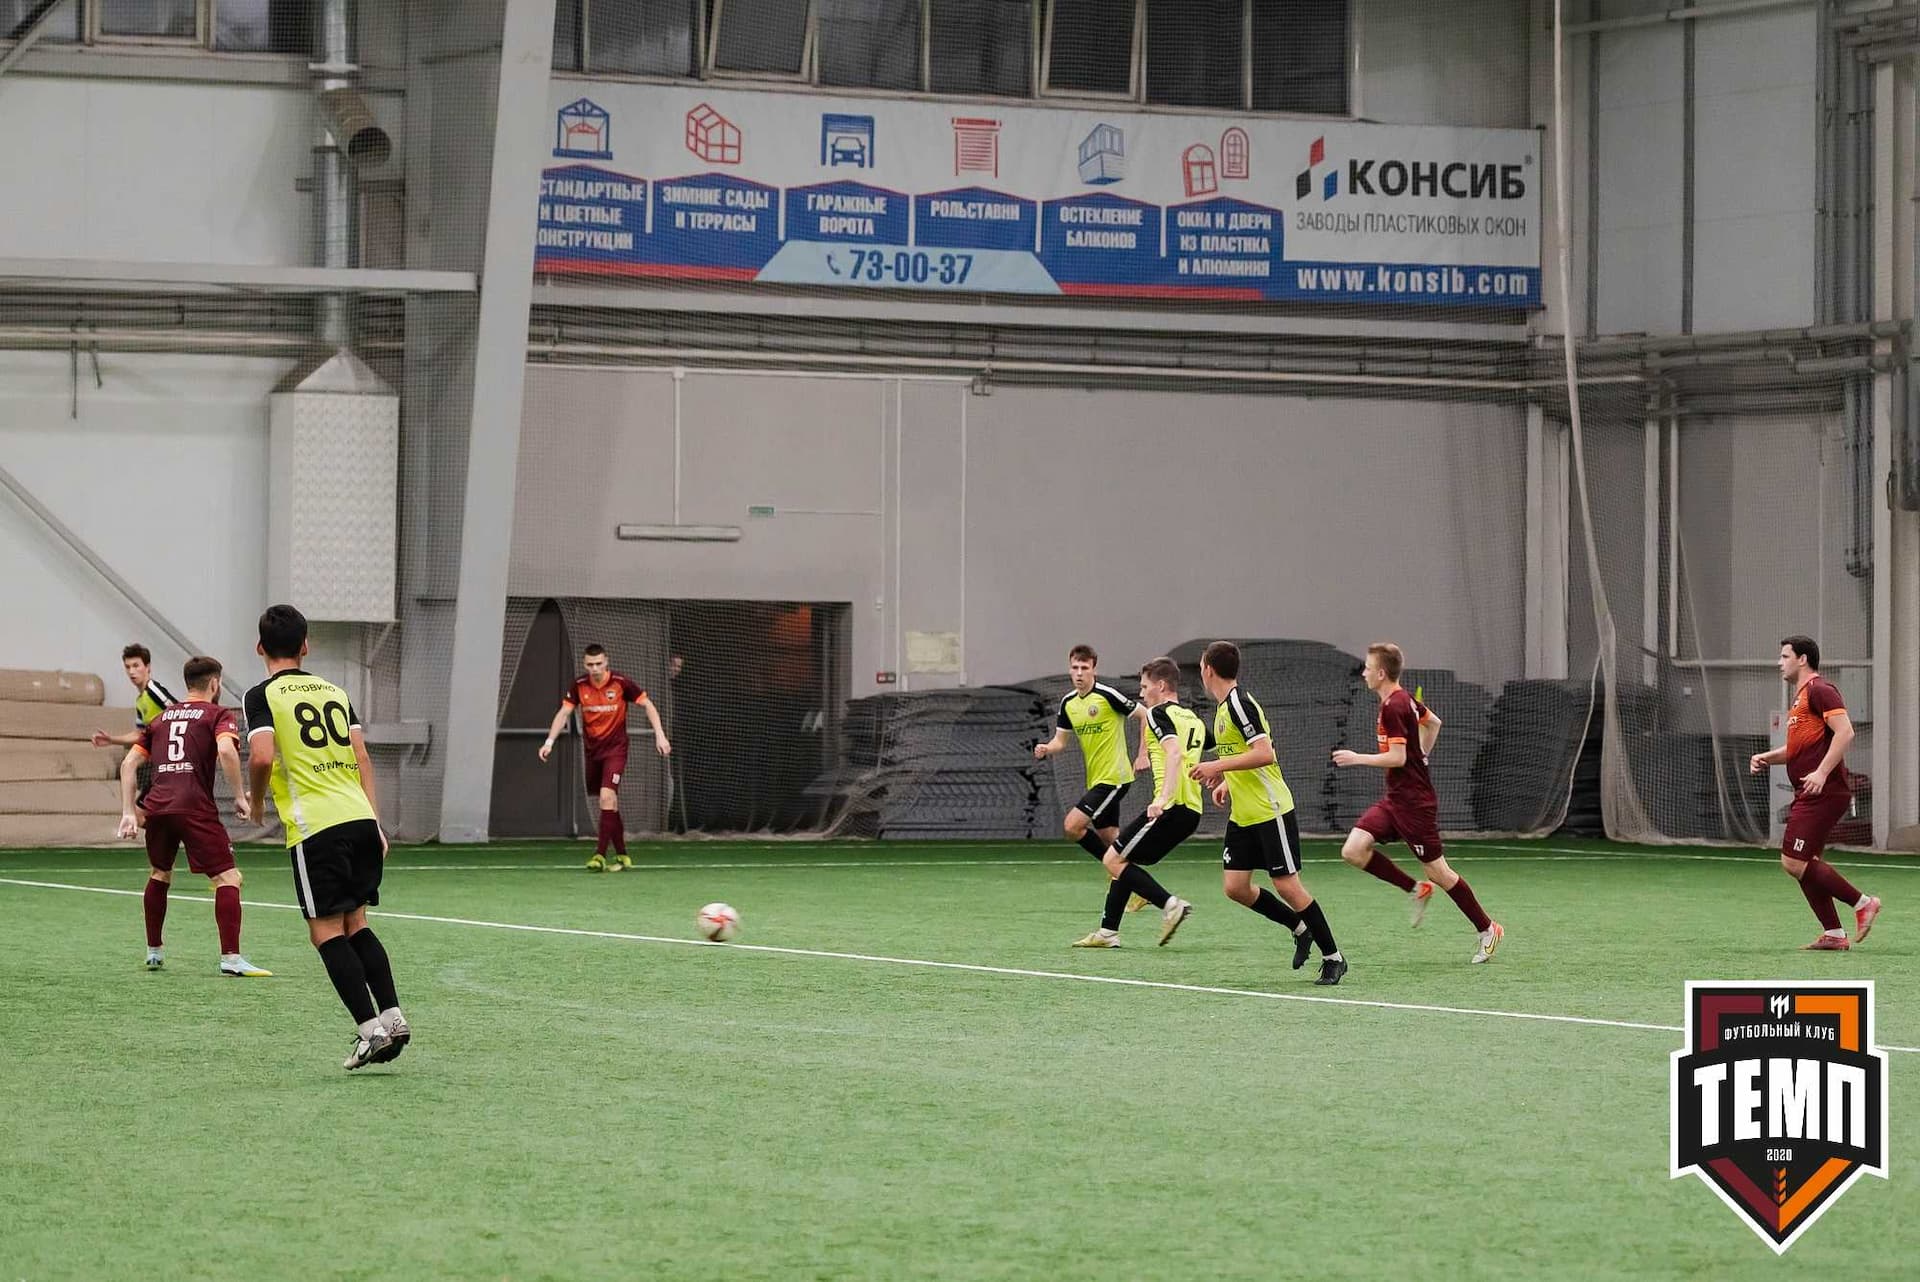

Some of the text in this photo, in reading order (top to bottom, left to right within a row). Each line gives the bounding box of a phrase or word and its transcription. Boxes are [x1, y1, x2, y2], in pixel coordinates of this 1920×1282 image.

[663, 186, 769, 209] ЗИМНИЕ САДЫ
[807, 193, 887, 215] ГАРАЖНЫЕ
[540, 204, 623, 225] И ЦВЕТНЫЕ
[930, 200, 1020, 221] РОЛЬСТАВНИ
[1059, 206, 1143, 226] ОСТЕКЛЕНИЕ
[1177, 211, 1272, 231] ОКНА И ДВЕРИ
[675, 212, 756, 233] И ТЕРРАСЫ
[819, 217, 875, 236] ВОРОТА
[1296, 211, 1526, 237] ЗАВОДЫ ПЛАСТИКОВЫХ ОКОН
[538, 229, 633, 250] ОНСТРУКЦИИ
[1066, 230, 1136, 250] БАЛКОНОВ
[1181, 235, 1271, 254] ИЗ ПЛАСТИКА
[850, 249, 974, 285] 73-00-37
[1179, 258, 1271, 277] И АЛЮМИНИЯ
[1297, 266, 1529, 295] www.konsib.com
[294, 701, 351, 749] 80
[168, 721, 188, 762] 5
[158, 762, 194, 773] SEUS
[1223, 847, 1231, 864] 4
[1793, 838, 1804, 852] 13
